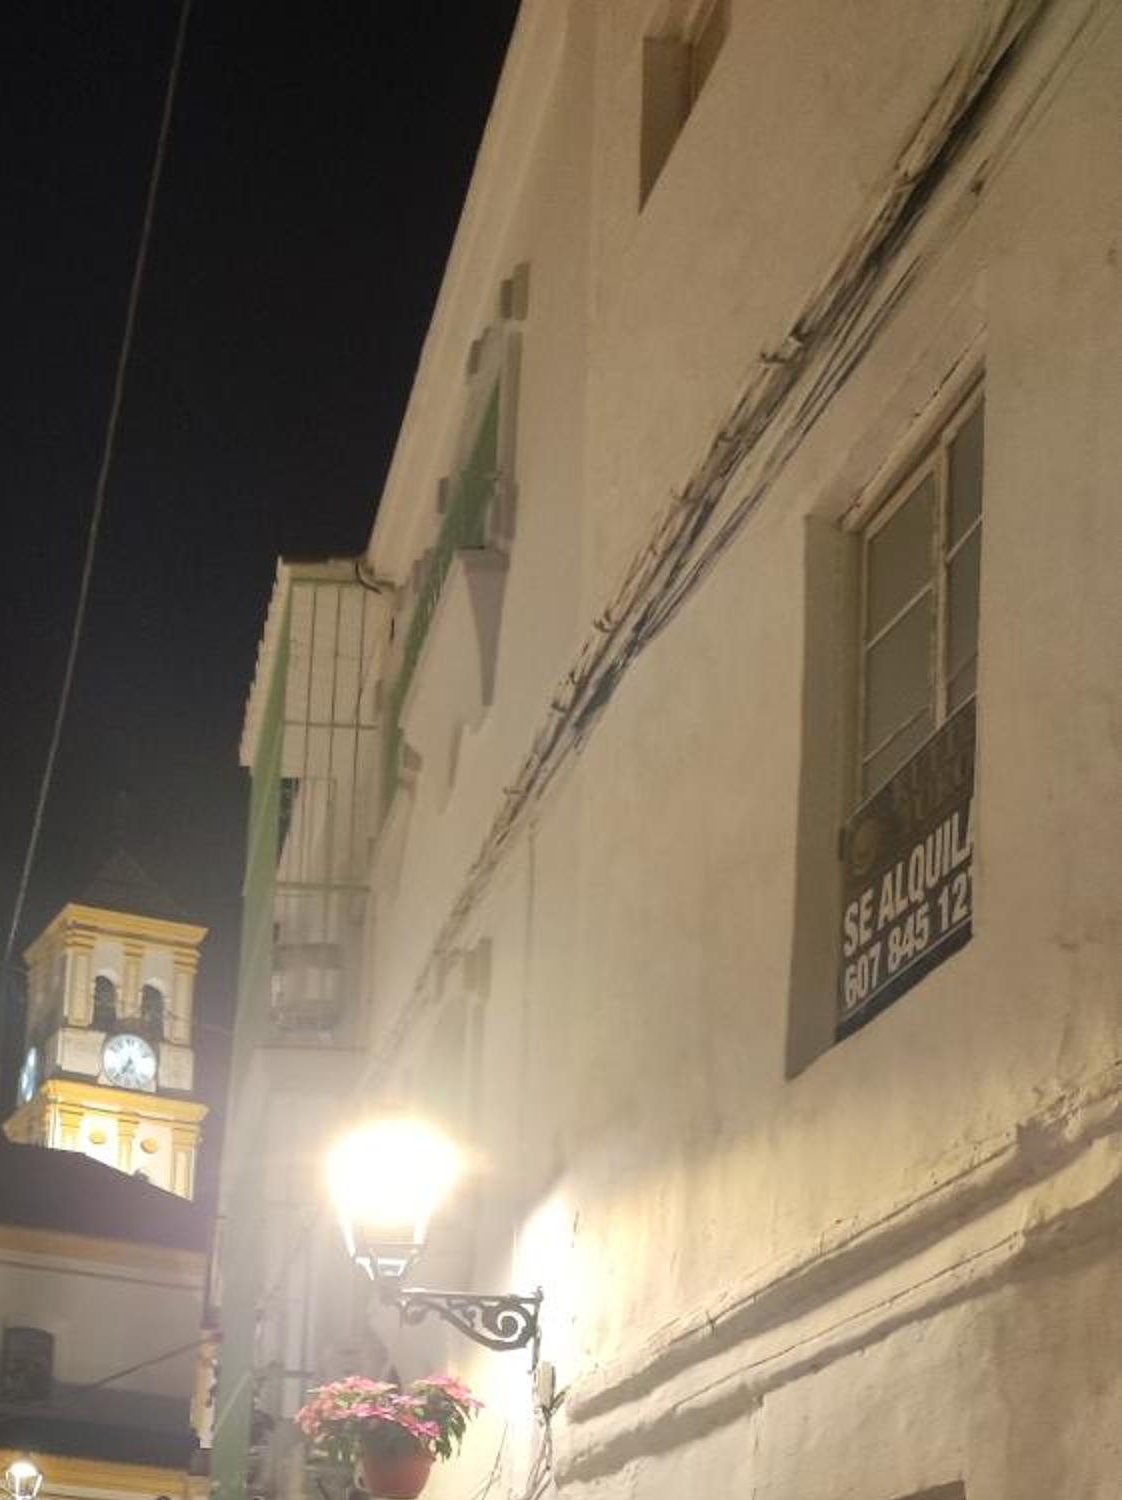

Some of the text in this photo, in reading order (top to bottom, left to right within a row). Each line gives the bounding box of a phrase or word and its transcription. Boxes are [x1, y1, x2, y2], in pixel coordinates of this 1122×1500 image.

[844, 888, 874, 957] SE
[845, 866, 973, 1009] 607 845 12
